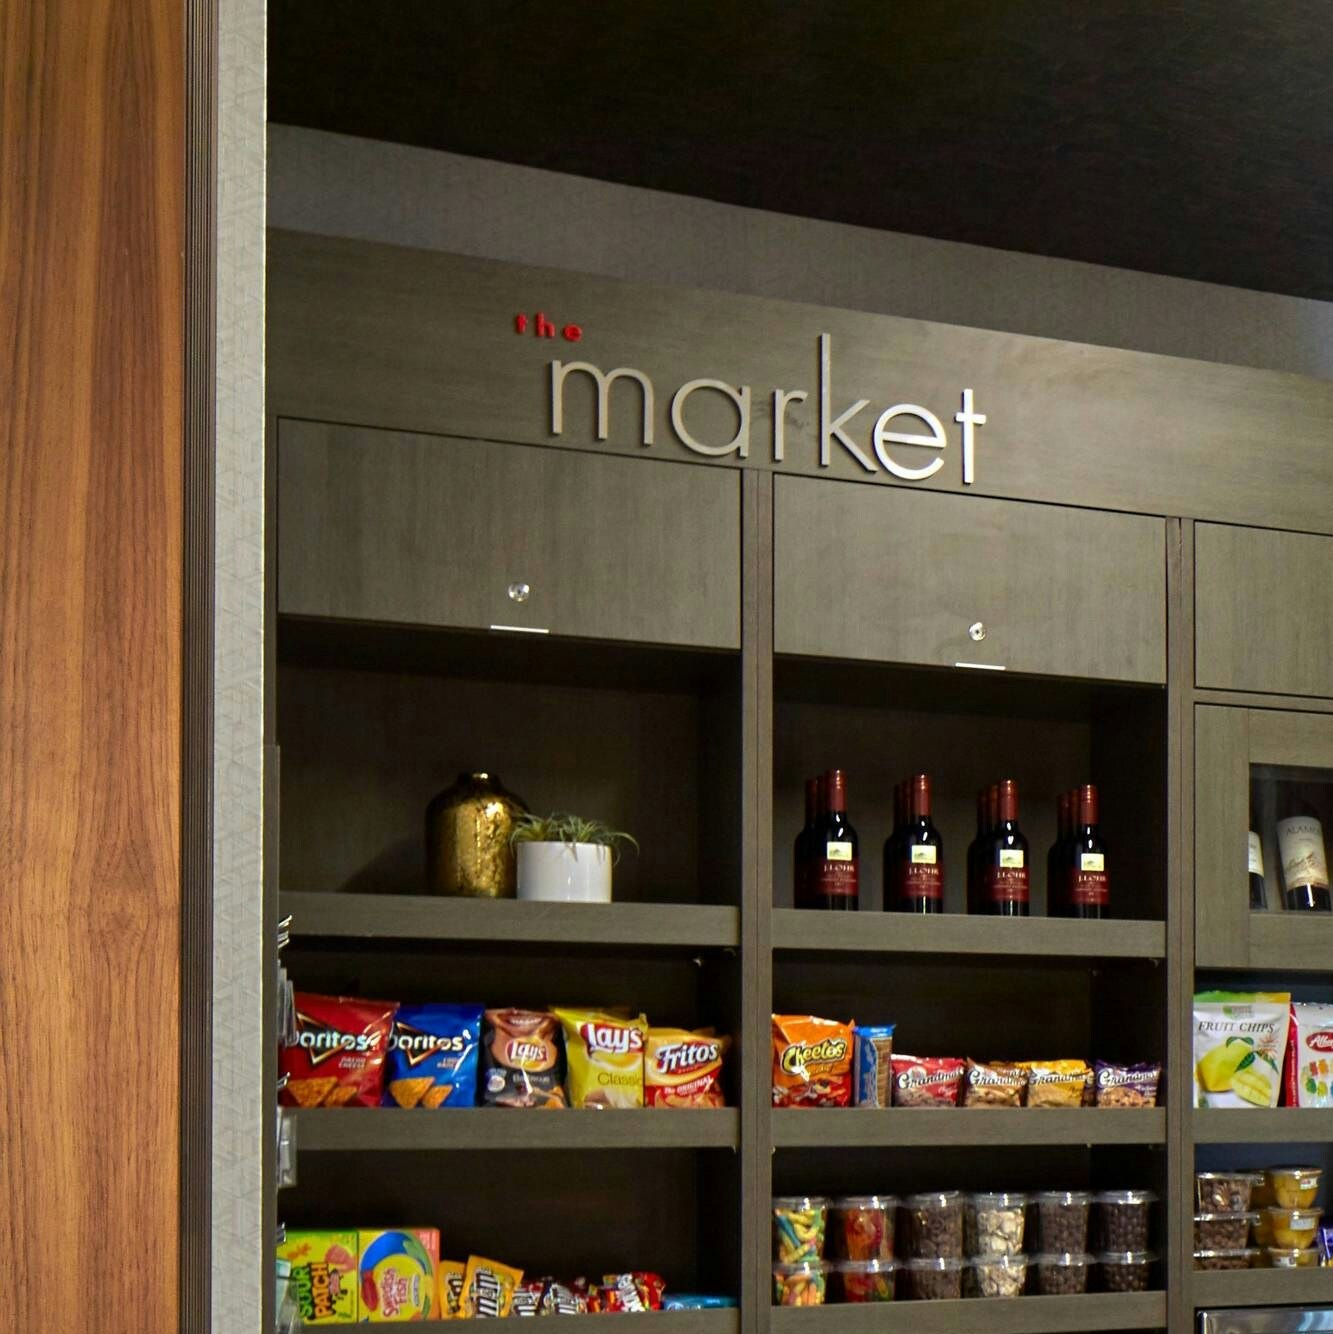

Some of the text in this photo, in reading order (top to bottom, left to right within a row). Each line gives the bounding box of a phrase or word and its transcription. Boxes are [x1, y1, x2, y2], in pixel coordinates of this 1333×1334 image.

[514, 312, 583, 342] the
[551, 332, 986, 484] market
[587, 1023, 643, 1054] Lay's
[1198, 1020, 1276, 1034] FRUIT CHIPS
[655, 1042, 720, 1074] Fritos
[782, 1039, 849, 1076] Cheetos
[312, 1261, 331, 1318] PATCH
